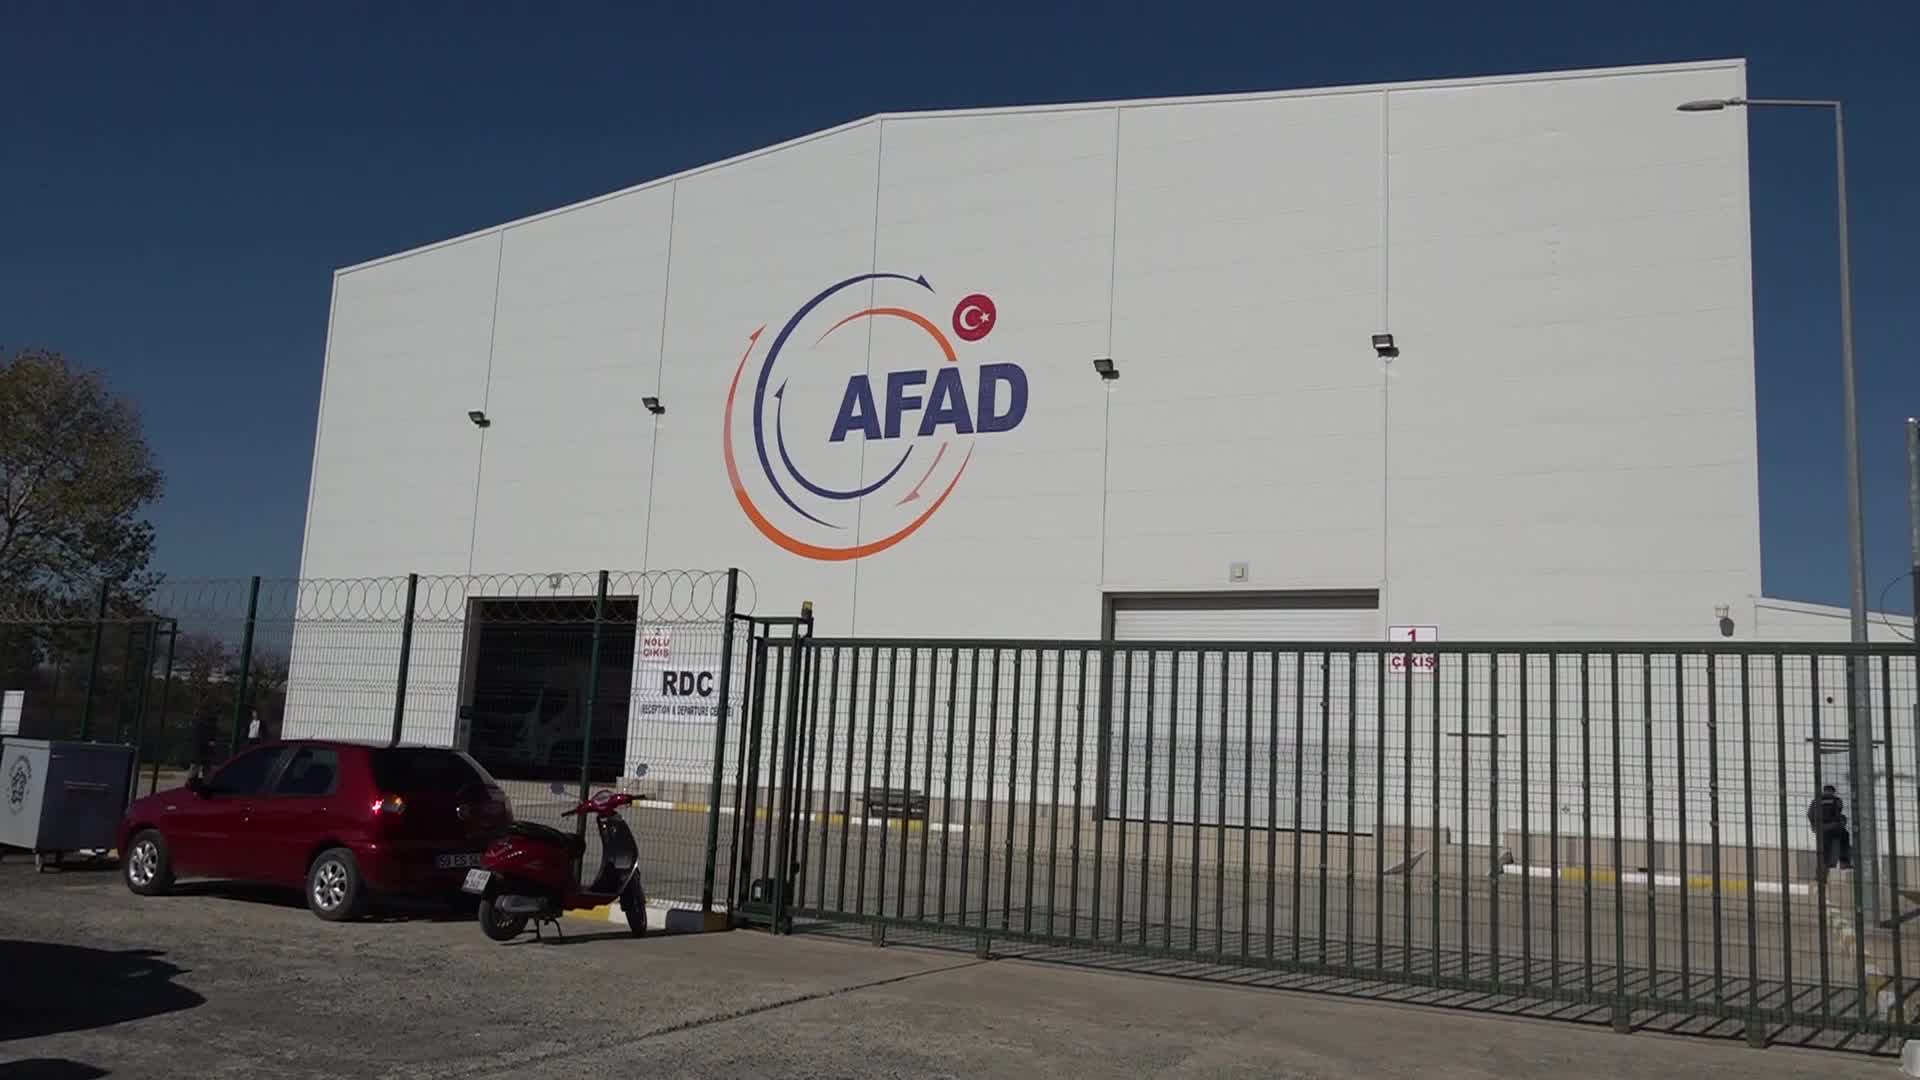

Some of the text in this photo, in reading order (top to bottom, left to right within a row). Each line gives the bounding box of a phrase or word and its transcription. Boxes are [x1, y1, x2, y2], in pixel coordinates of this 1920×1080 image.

[829, 363, 1028, 442] AFAD
[643, 638, 670, 647] NOLU
[1408, 628, 1417, 642] 1
[662, 671, 713, 697] RDC
